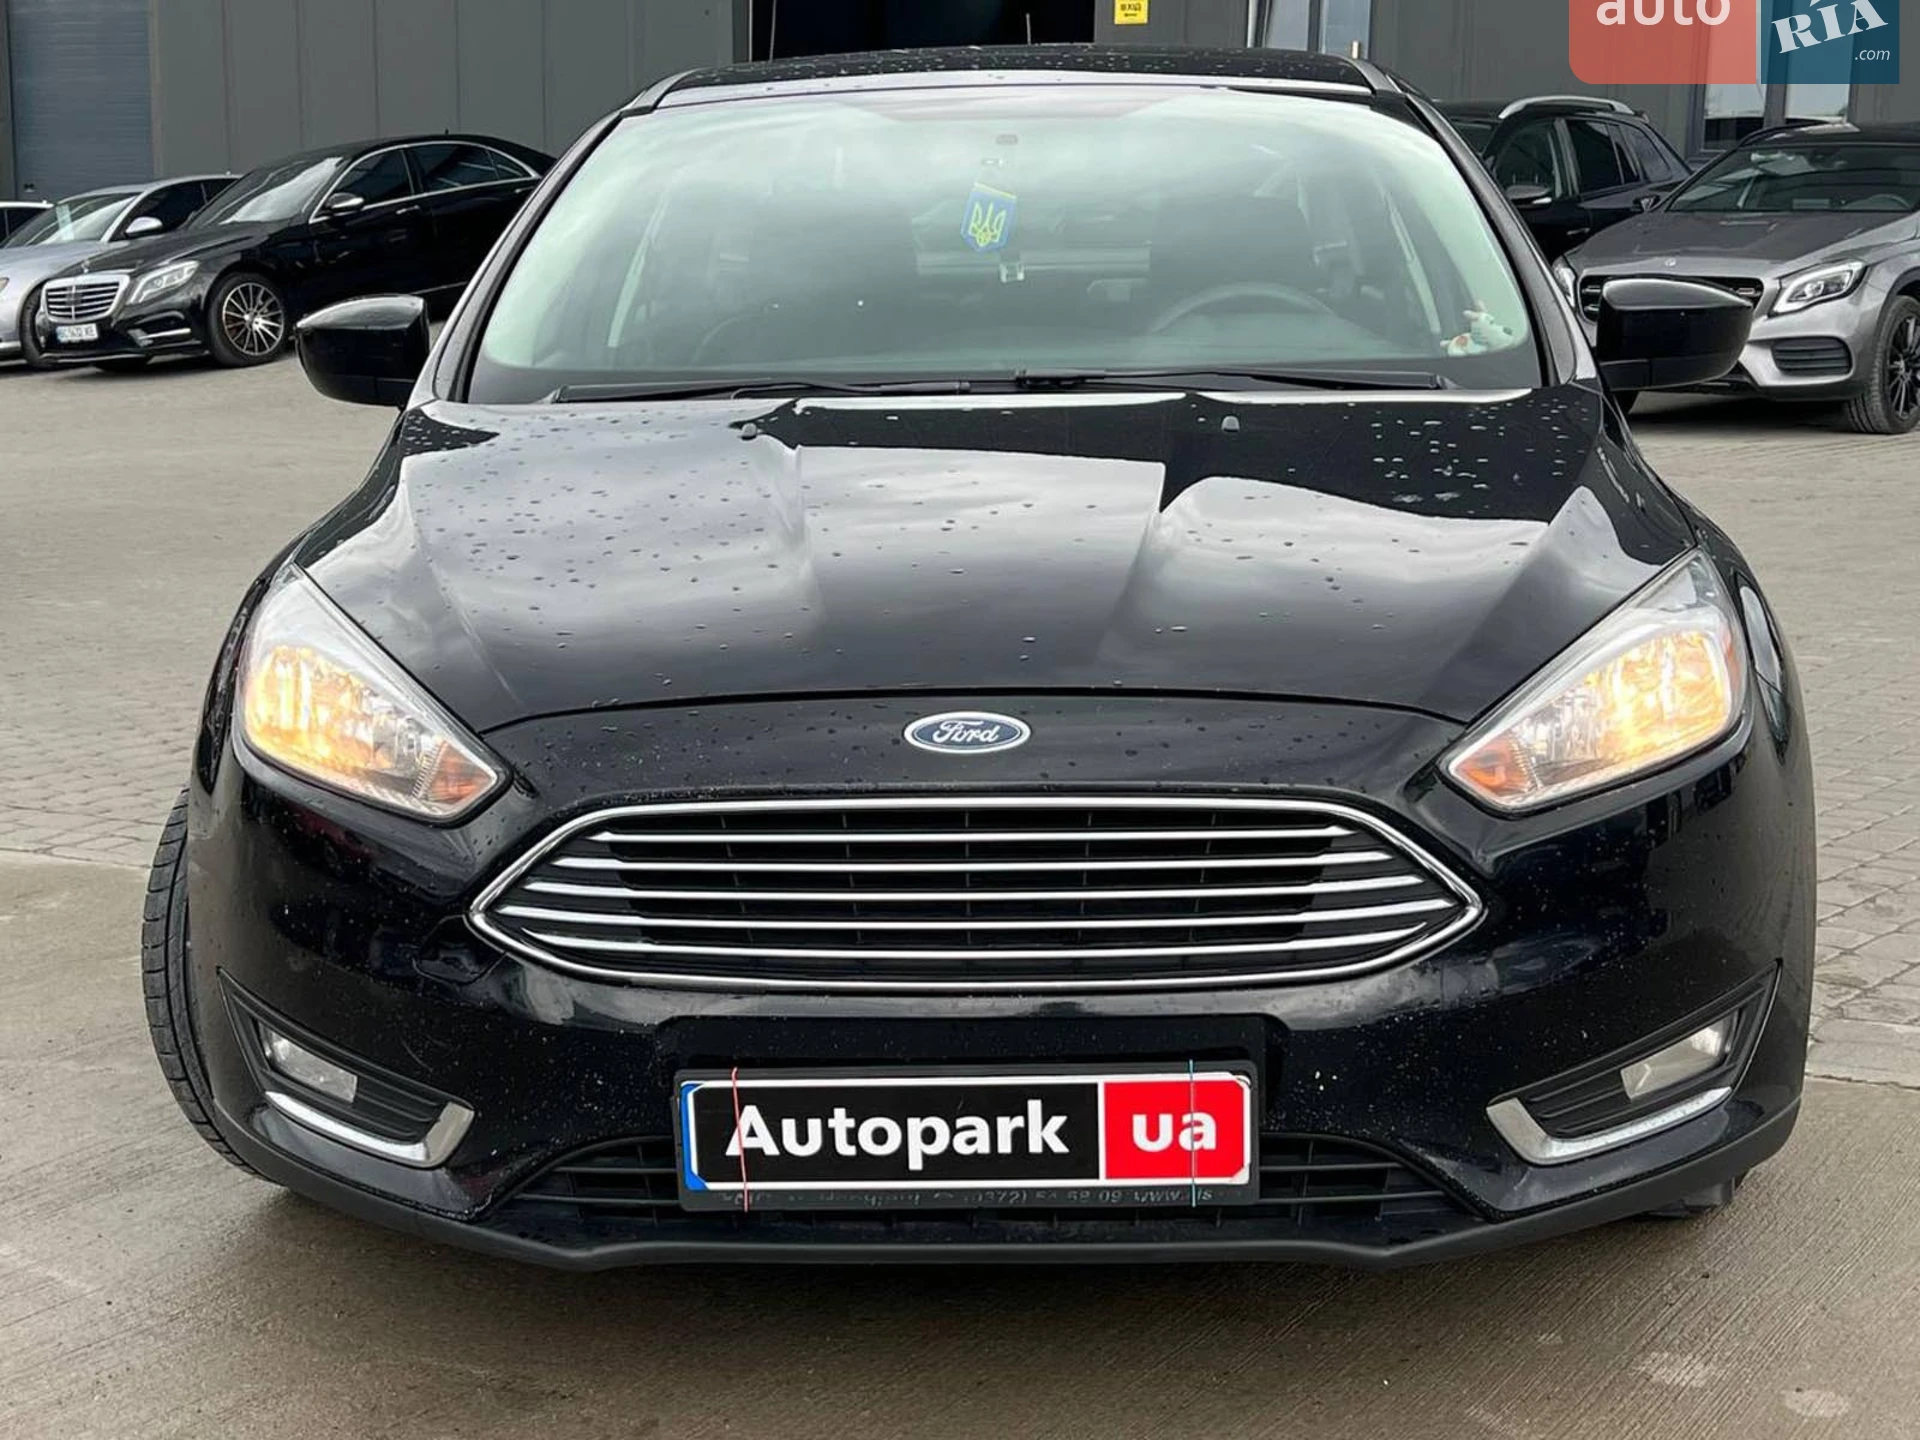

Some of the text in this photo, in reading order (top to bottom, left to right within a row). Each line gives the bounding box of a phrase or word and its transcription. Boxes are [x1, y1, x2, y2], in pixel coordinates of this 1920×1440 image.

[932, 720, 1001, 743] Ford
[725, 1099, 1217, 1171] Autopark ua
